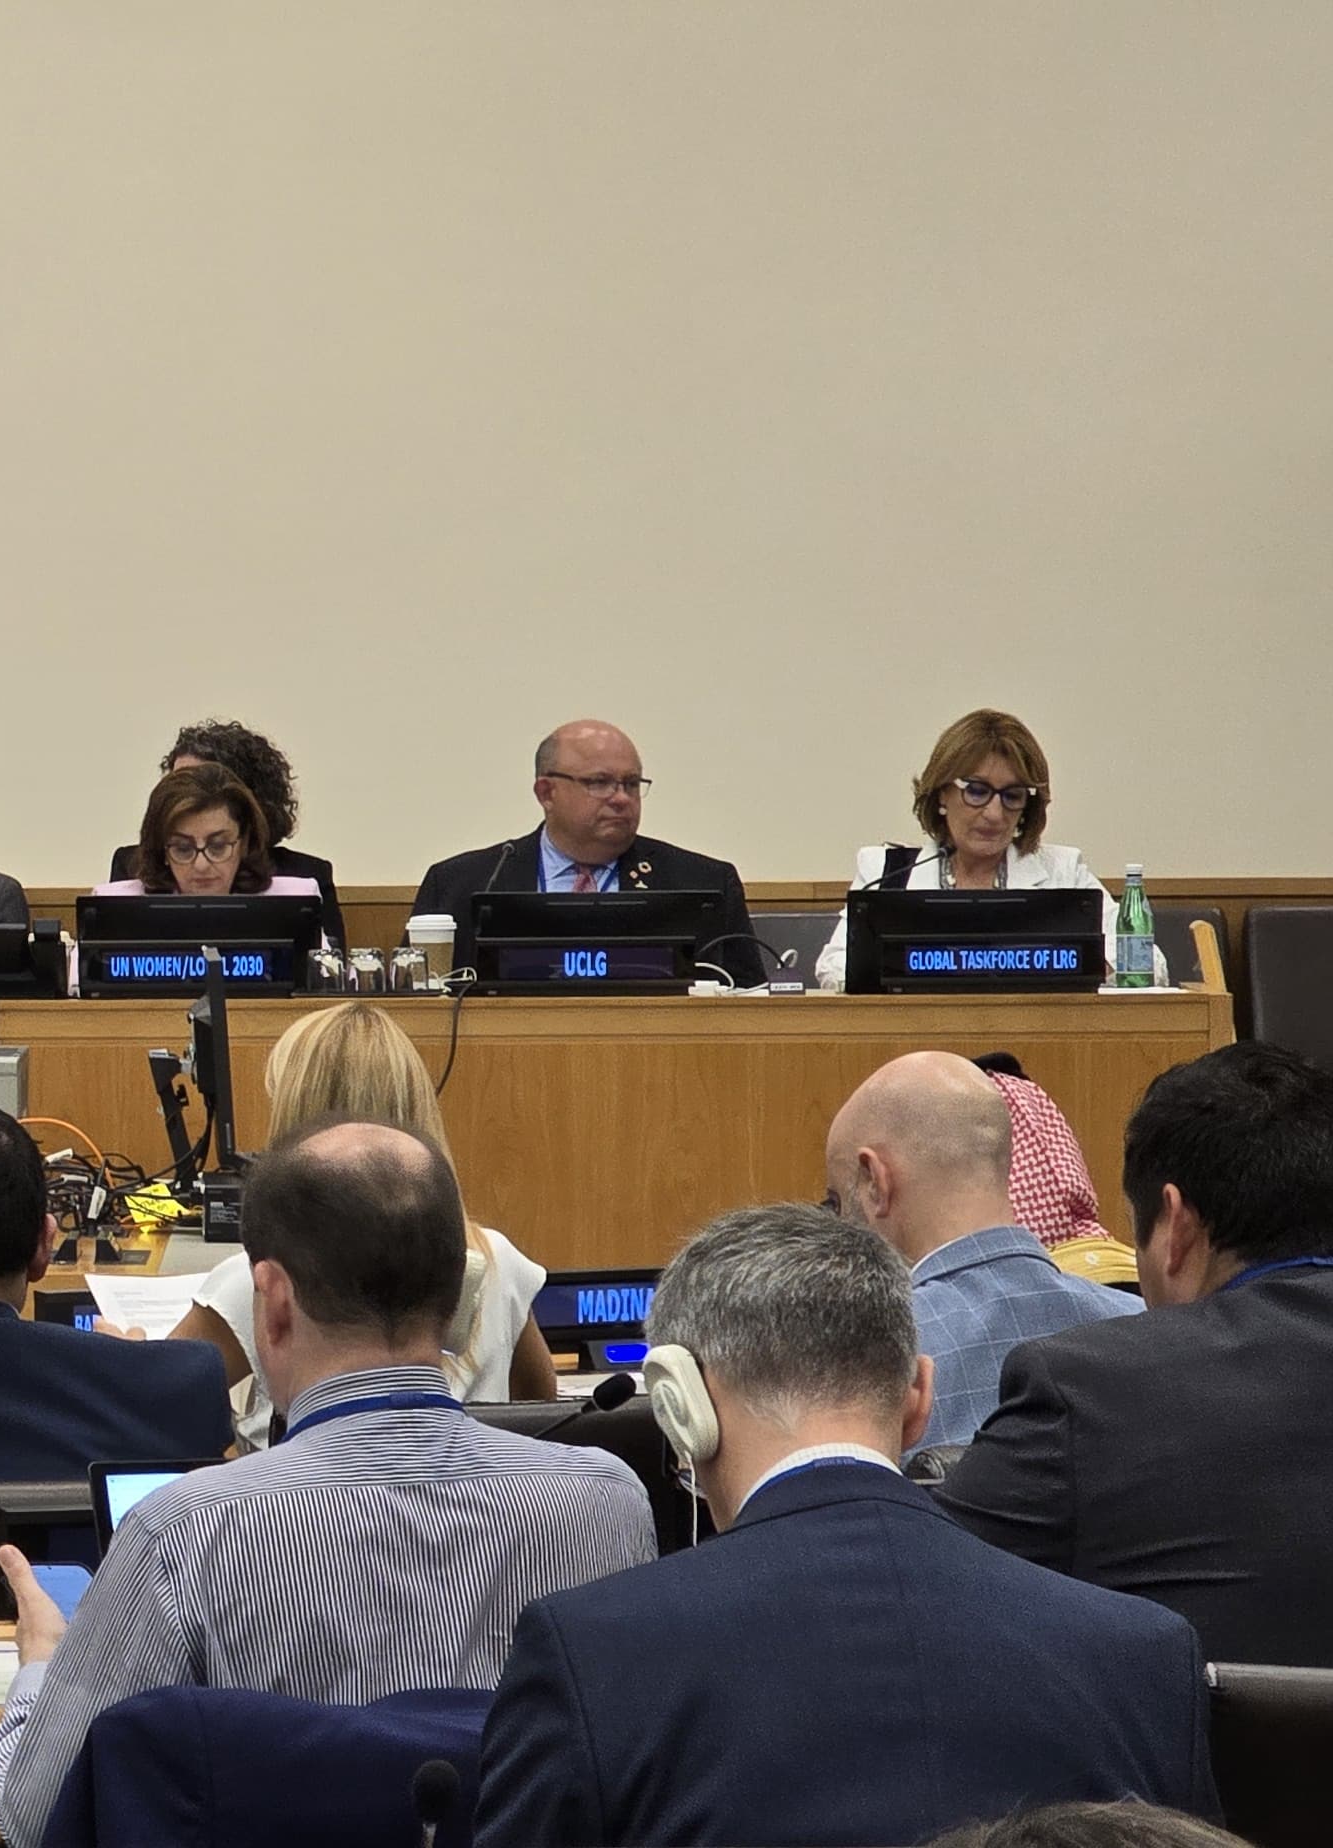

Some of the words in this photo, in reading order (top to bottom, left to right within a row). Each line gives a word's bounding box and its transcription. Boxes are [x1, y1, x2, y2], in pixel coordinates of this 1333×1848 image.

[110, 956, 130, 977] UN
[132, 955, 230, 980] WOMEN/LOL
[232, 955, 264, 977] 2030
[563, 951, 607, 977] UCLG
[909, 950, 958, 970] GLOBAL
[960, 950, 1031, 970] TASKFORCE
[1033, 949, 1051, 969] OF
[1053, 949, 1077, 969] LRG
